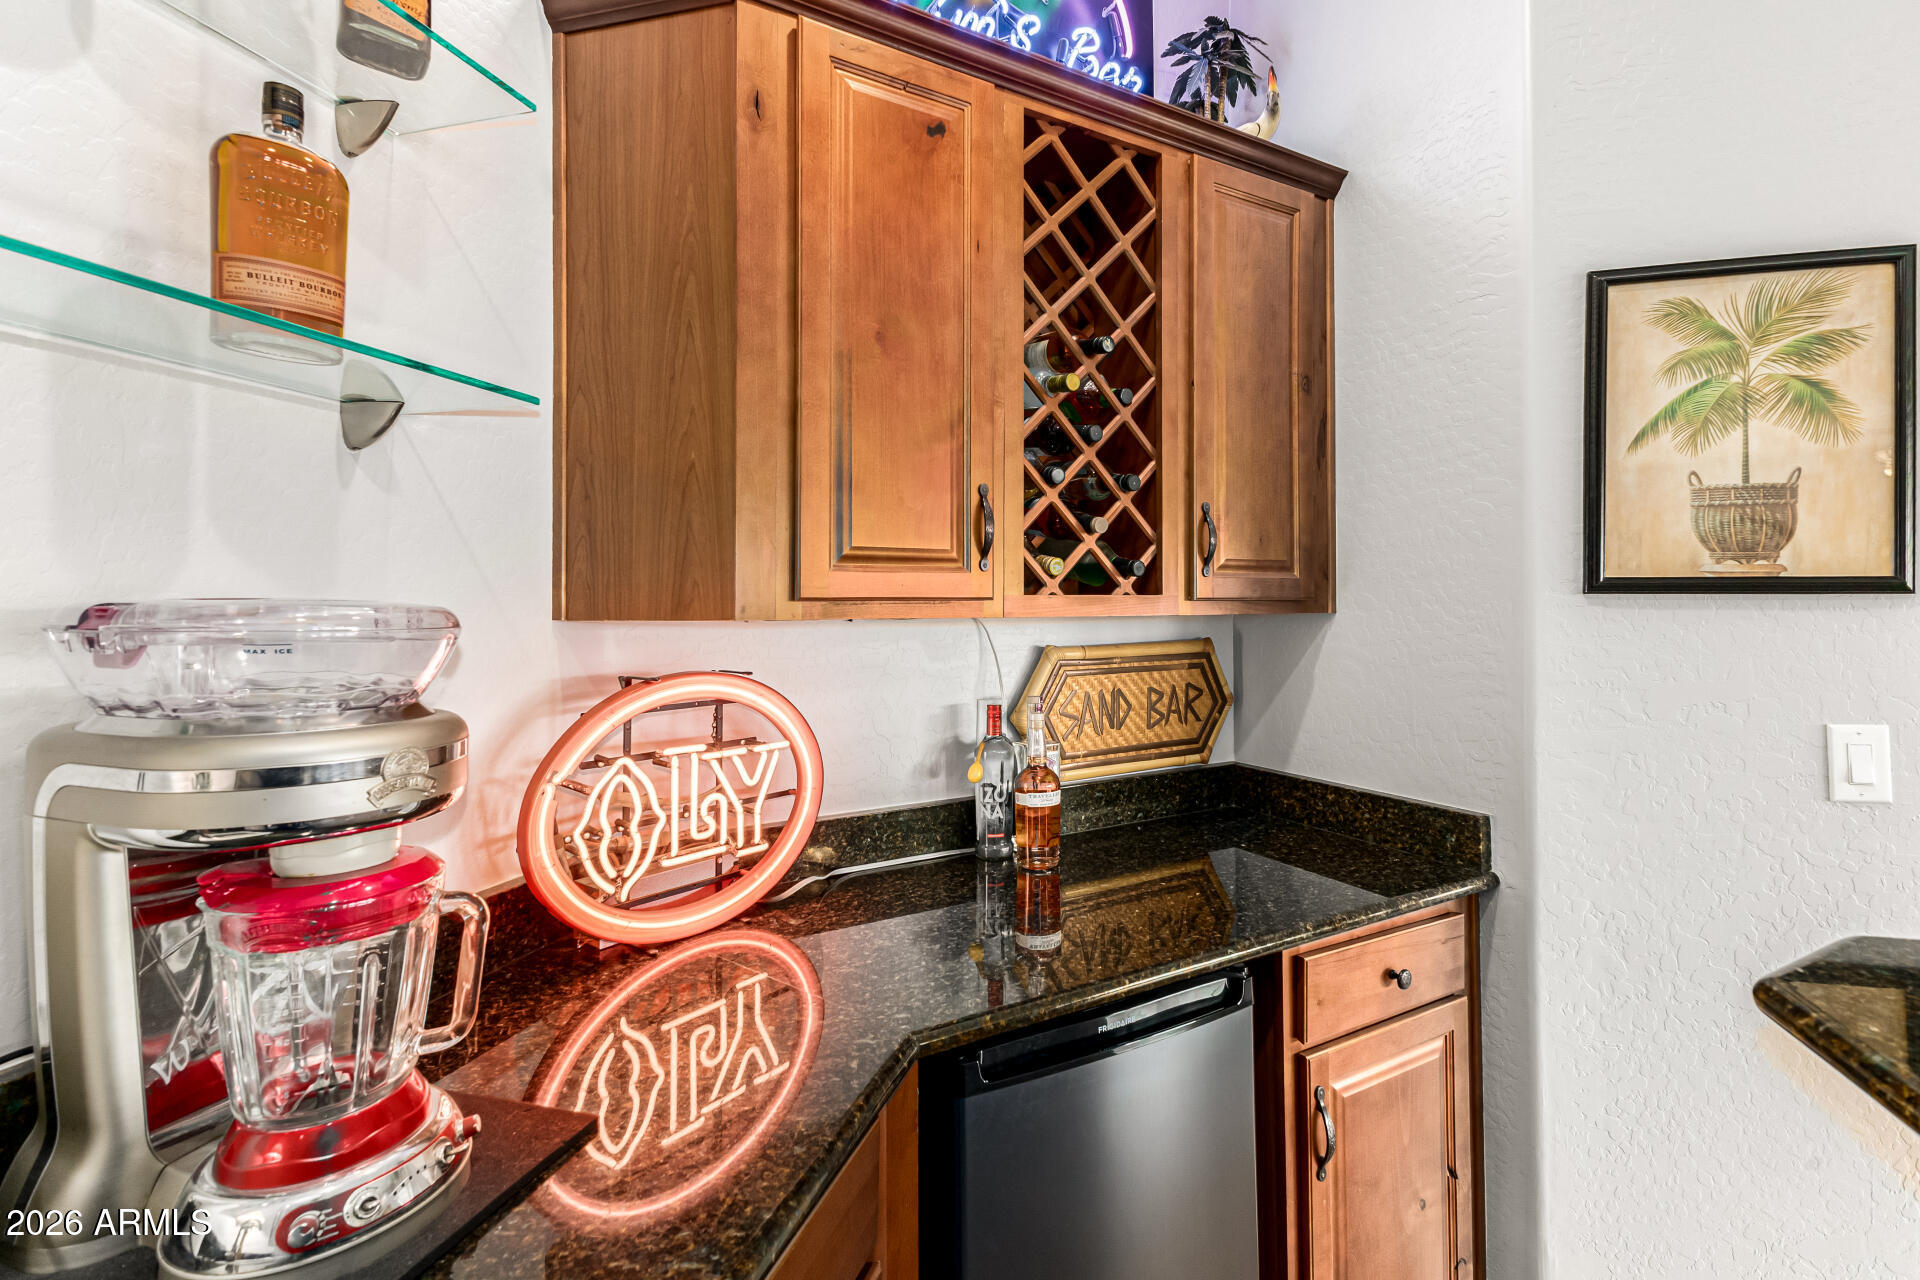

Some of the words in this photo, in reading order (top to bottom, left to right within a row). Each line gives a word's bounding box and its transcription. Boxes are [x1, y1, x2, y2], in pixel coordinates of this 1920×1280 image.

[247, 271, 295, 286] BULLEIT
[1058, 687, 1132, 741] SAND
[1146, 682, 1203, 731] BAR
[573, 740, 790, 902] OLY
[1097, 1015, 1136, 1034] FRIGIDAIRE
